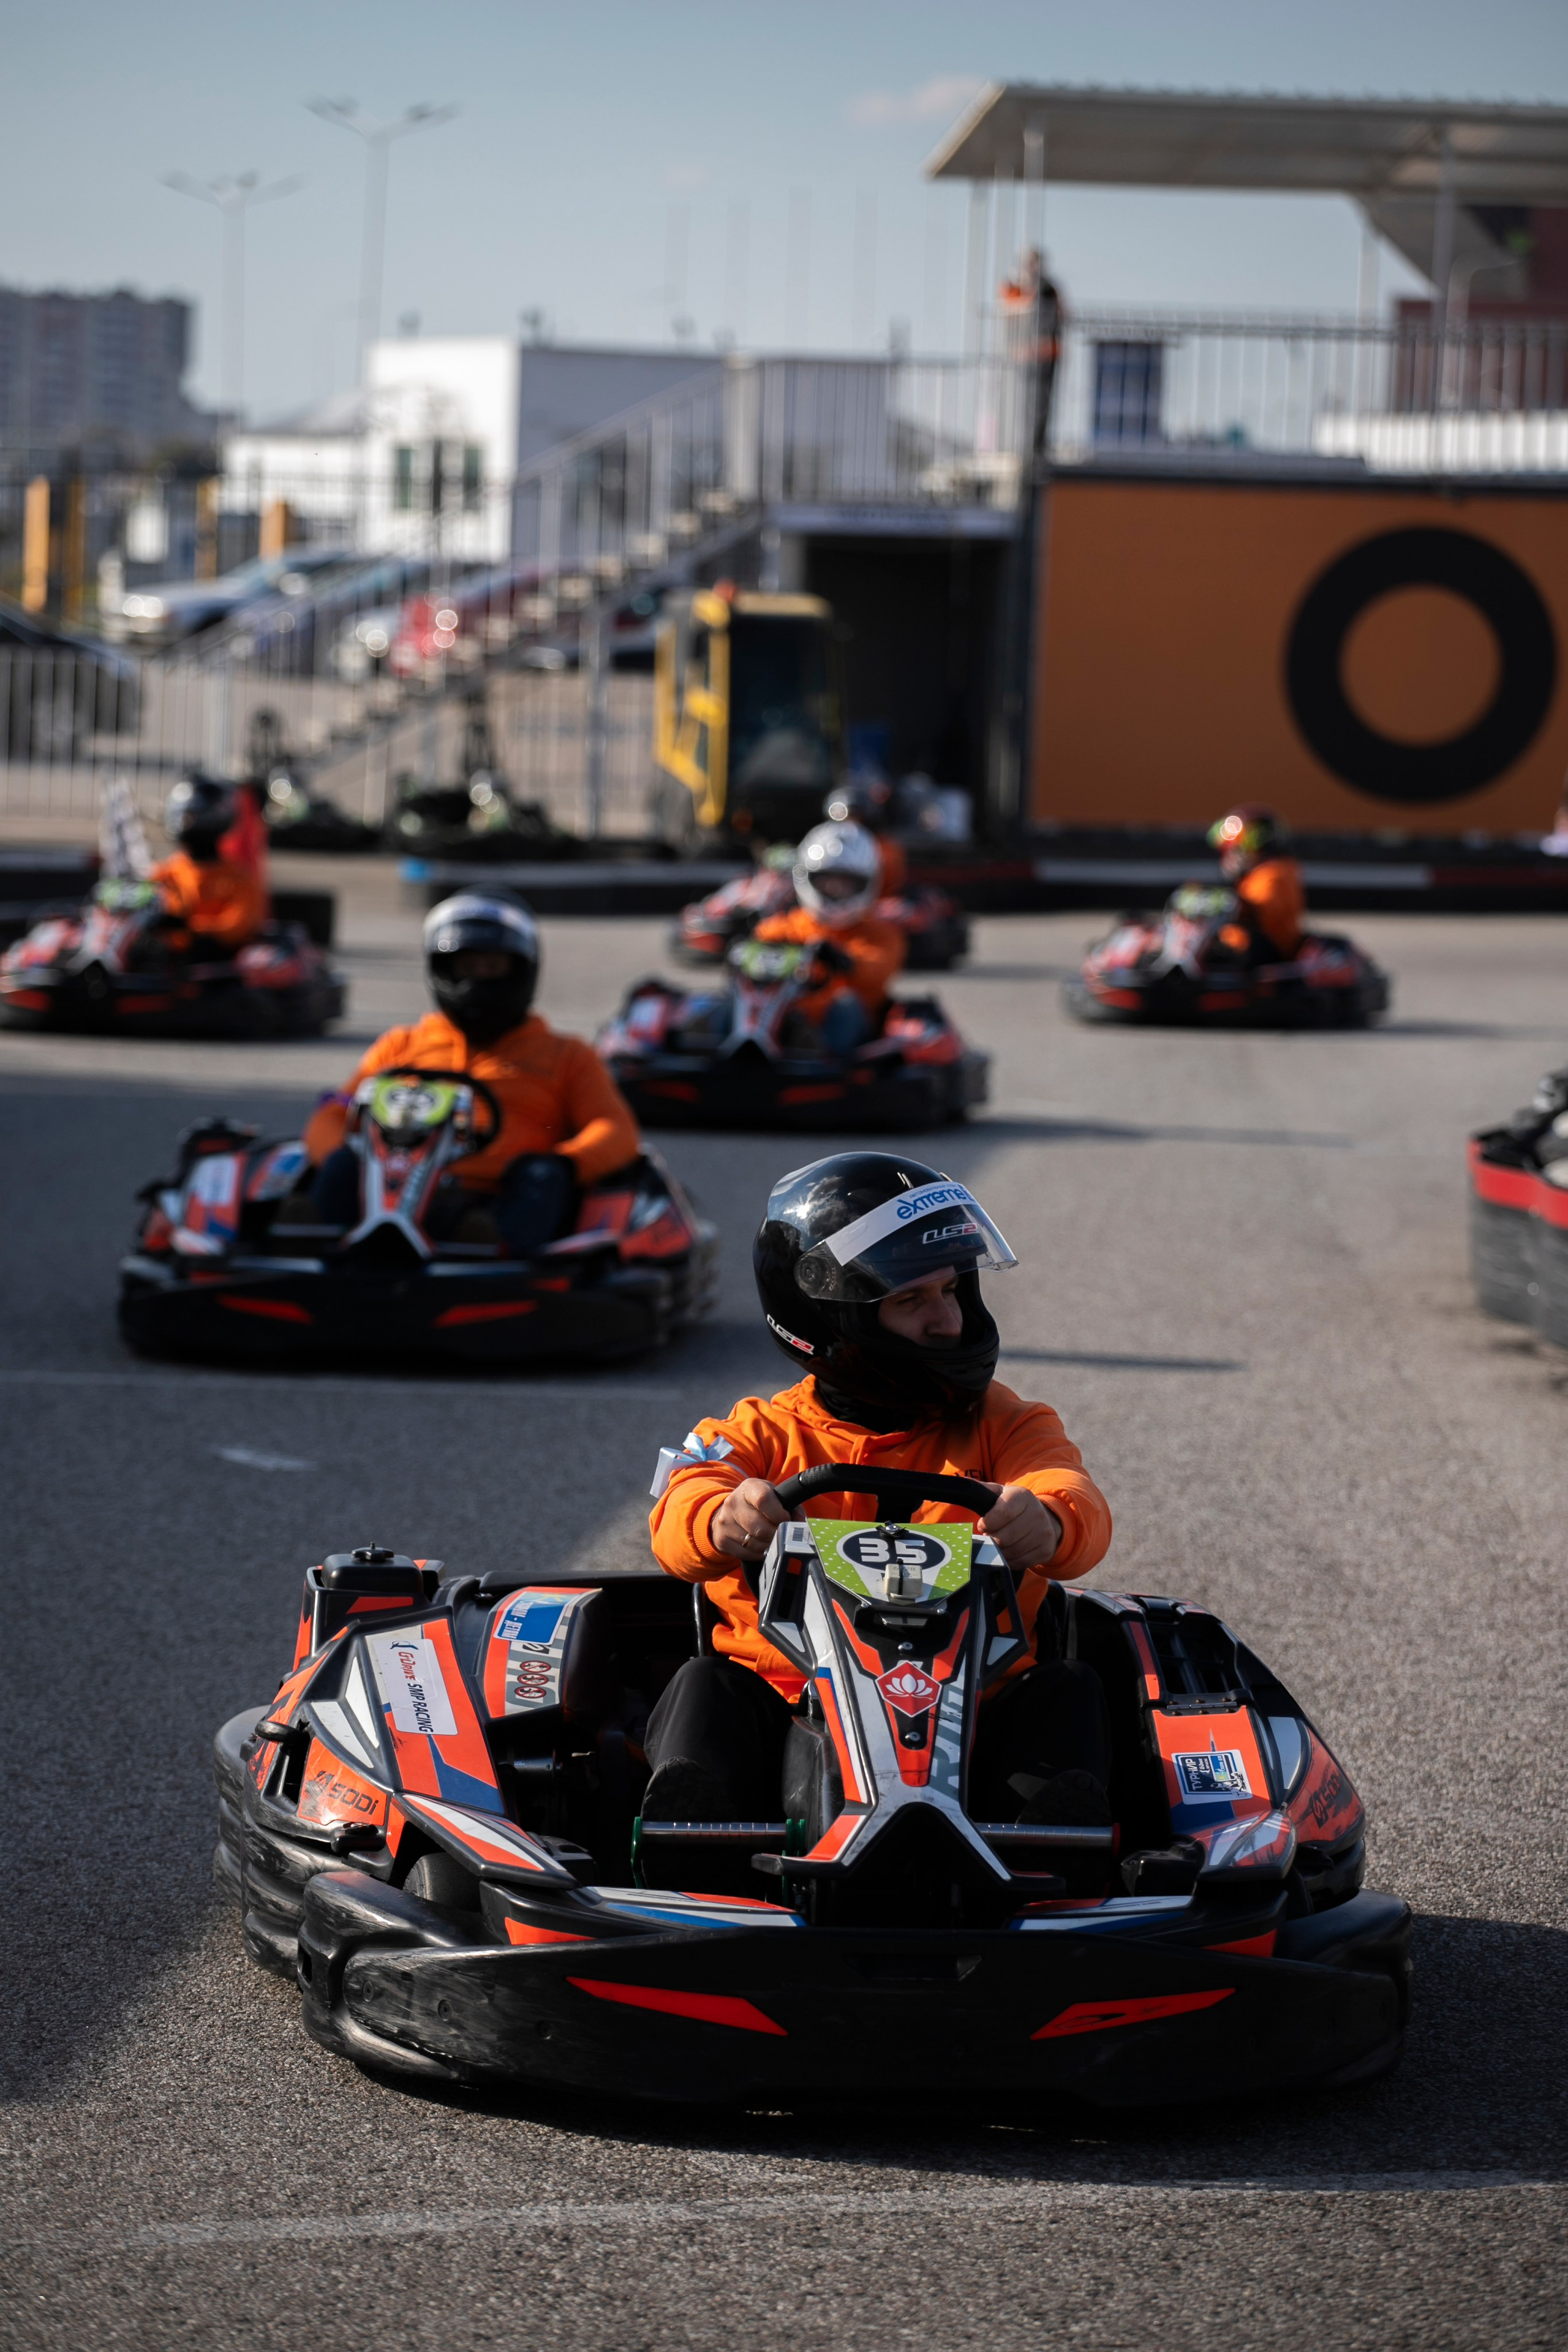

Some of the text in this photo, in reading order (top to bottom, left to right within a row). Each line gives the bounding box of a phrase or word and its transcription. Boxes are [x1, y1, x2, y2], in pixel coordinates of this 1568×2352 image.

[922, 1223, 978, 1245] LS2
[767, 1314, 815, 1355] LS2
[859, 1537, 927, 1564] 35
[407, 1683, 426, 1700] SMP
[412, 1701, 434, 1733] RACING
[1185, 1758, 1202, 1790] ТУРНИР
